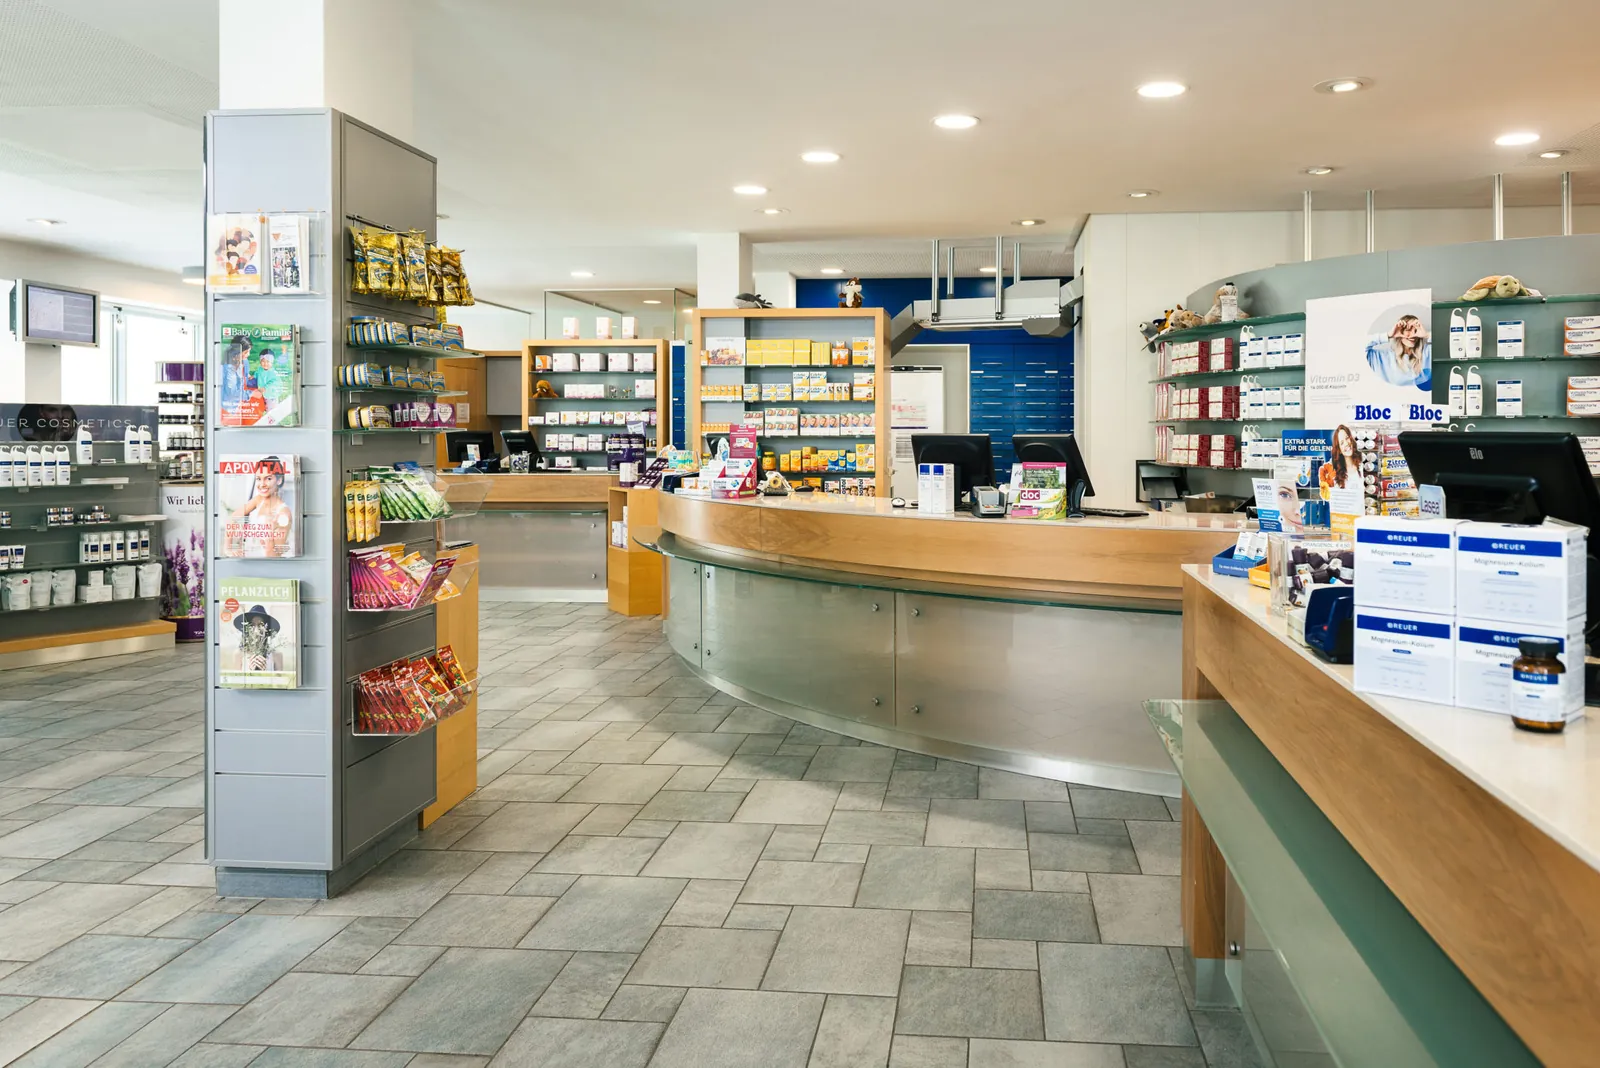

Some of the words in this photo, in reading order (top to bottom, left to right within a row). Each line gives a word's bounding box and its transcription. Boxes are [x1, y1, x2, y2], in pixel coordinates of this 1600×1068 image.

[232, 328, 252, 337] Baby
[262, 327, 292, 336] Familie
[1311, 374, 1345, 384] Vitamin
[1348, 373, 1360, 382] D3
[1355, 405, 1391, 420] Bloc
[1409, 404, 1442, 420] Bloc
[0, 418, 28, 428] ER
[37, 418, 132, 428] COSMETICS
[224, 462, 290, 474] APOVITAL
[1021, 490, 1040, 499] doc
[166, 496, 184, 505] Wir
[1421, 496, 1440, 514] Lasea
[222, 586, 289, 598] PFLANZLICH
